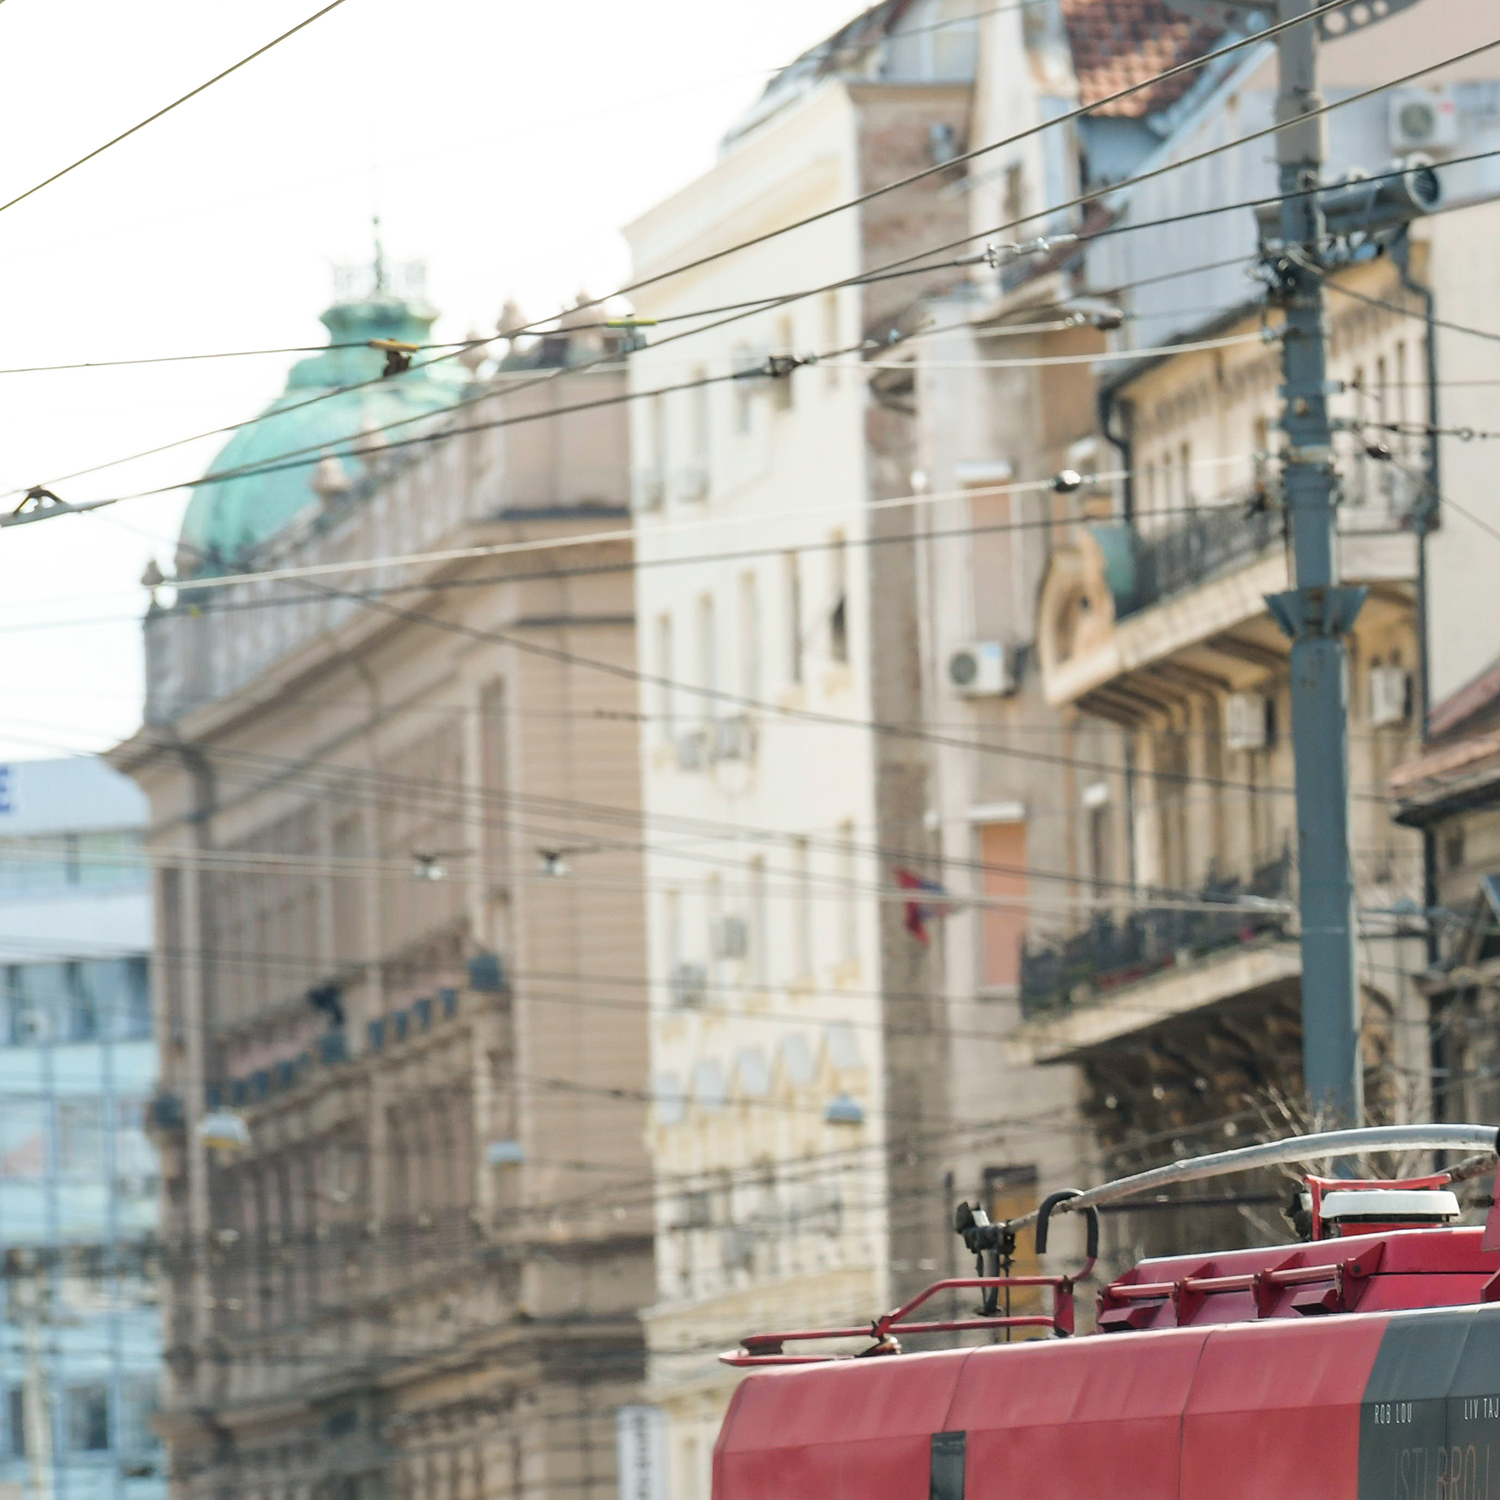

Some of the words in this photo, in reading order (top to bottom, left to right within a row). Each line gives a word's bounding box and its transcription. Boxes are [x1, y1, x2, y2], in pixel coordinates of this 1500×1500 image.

[1374, 1403, 1391, 1424] ROB
[1396, 1402, 1412, 1423] LOU
[1464, 1399, 1479, 1420] LIV
